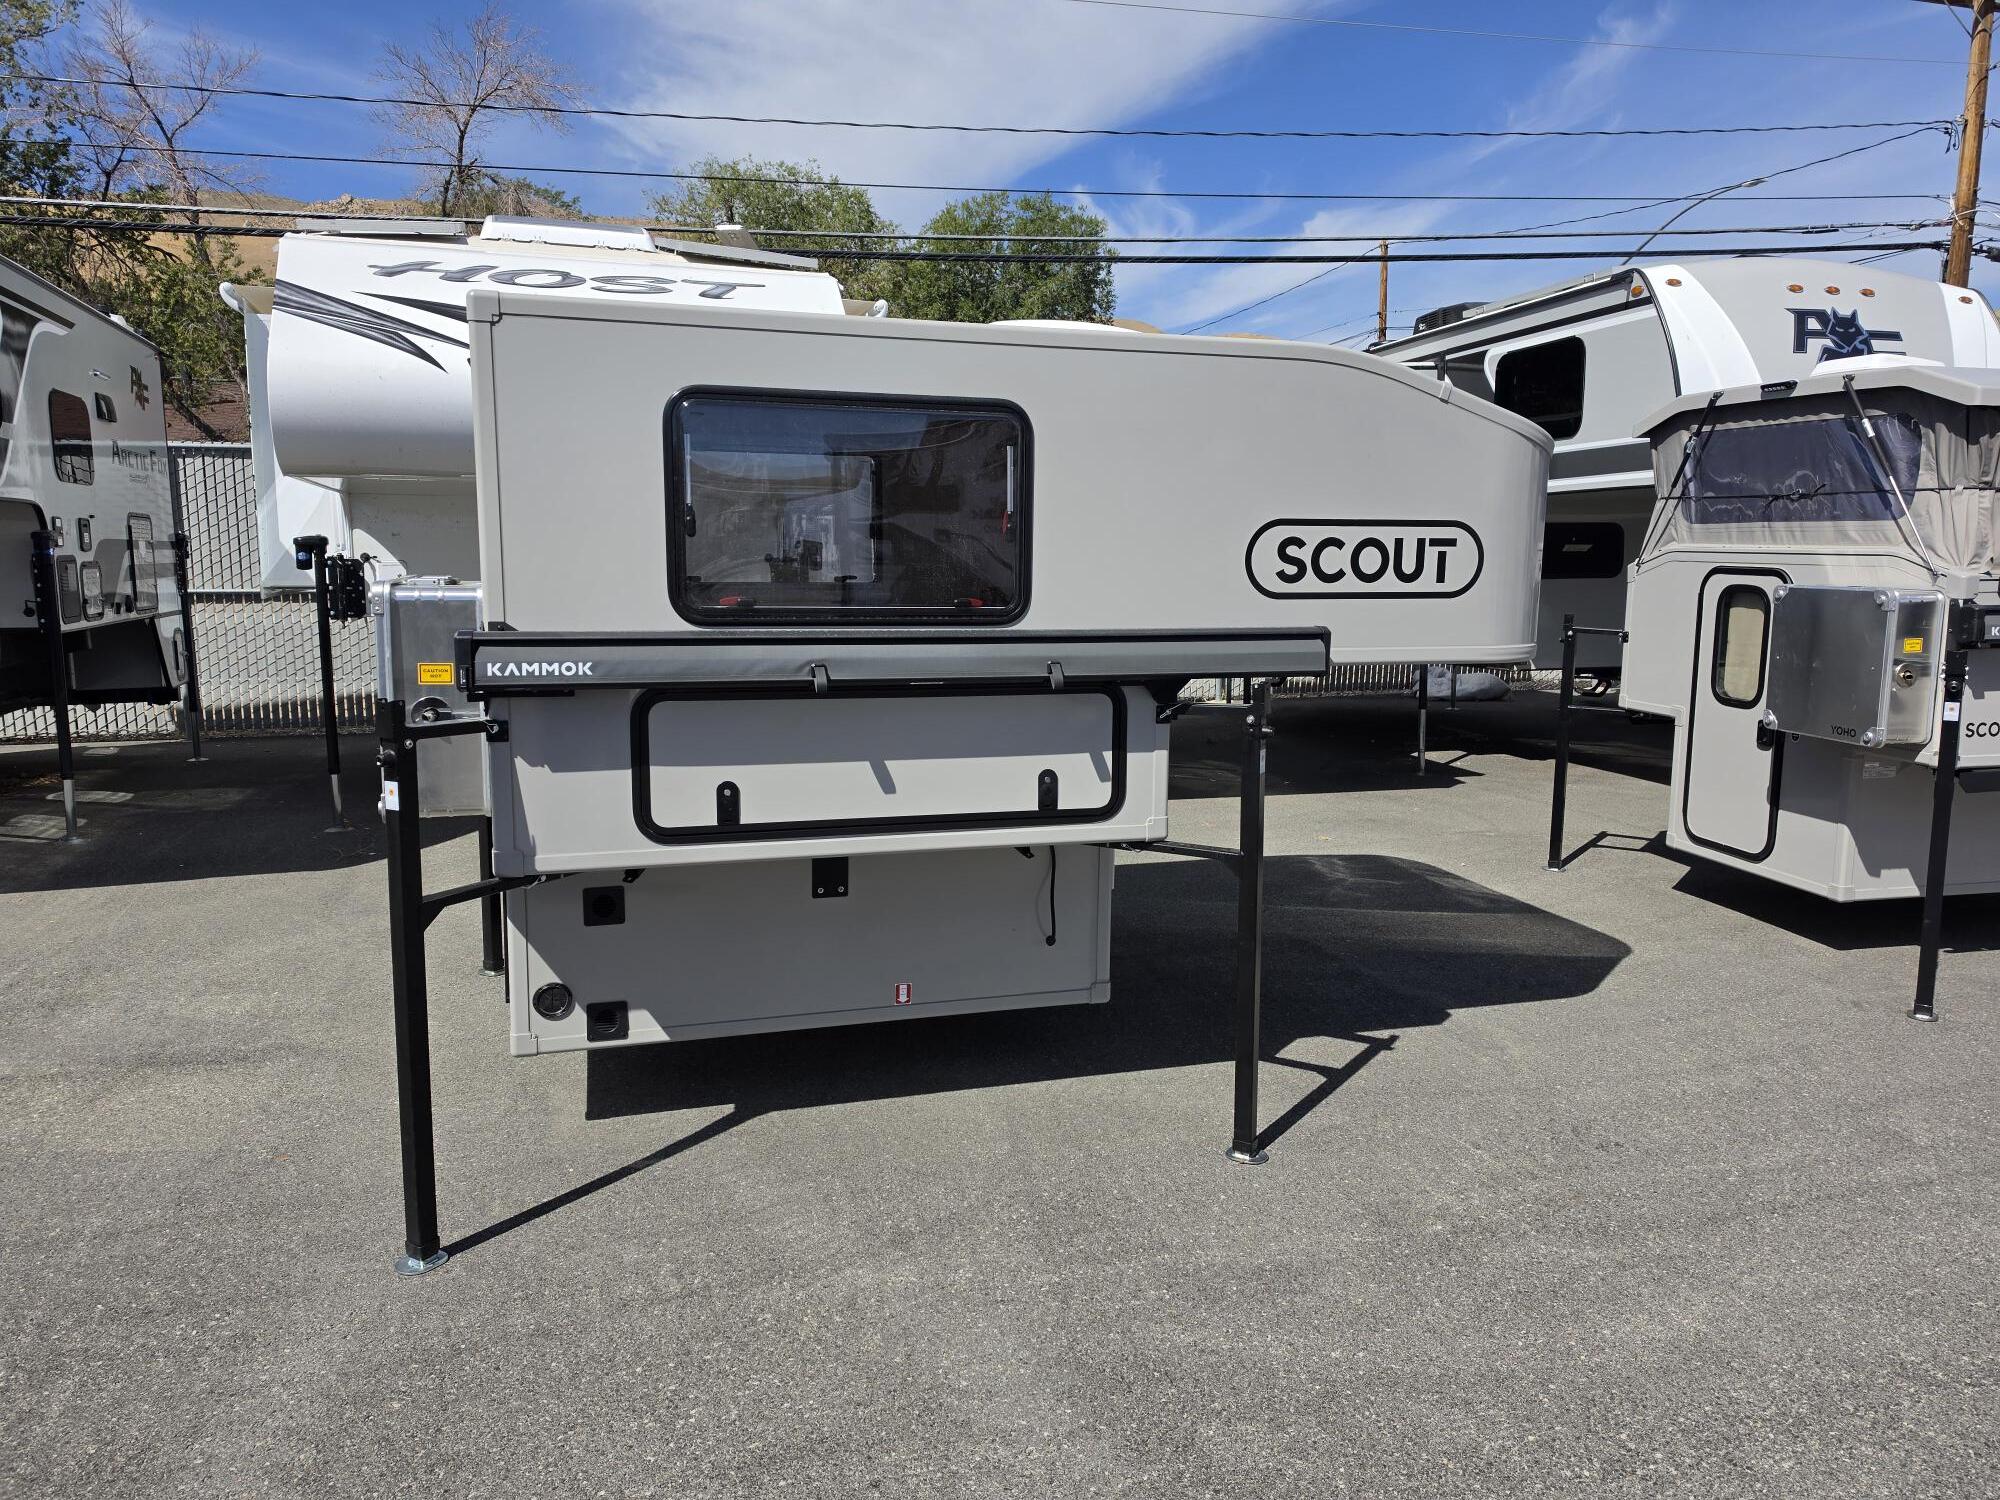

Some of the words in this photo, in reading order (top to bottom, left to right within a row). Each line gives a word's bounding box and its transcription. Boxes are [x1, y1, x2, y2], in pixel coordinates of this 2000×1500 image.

[367, 260, 766, 300] HOST
[1275, 536, 1458, 584] SCOUT
[486, 661, 593, 676] KAMMOK
[1831, 725, 1857, 738] YOHO
